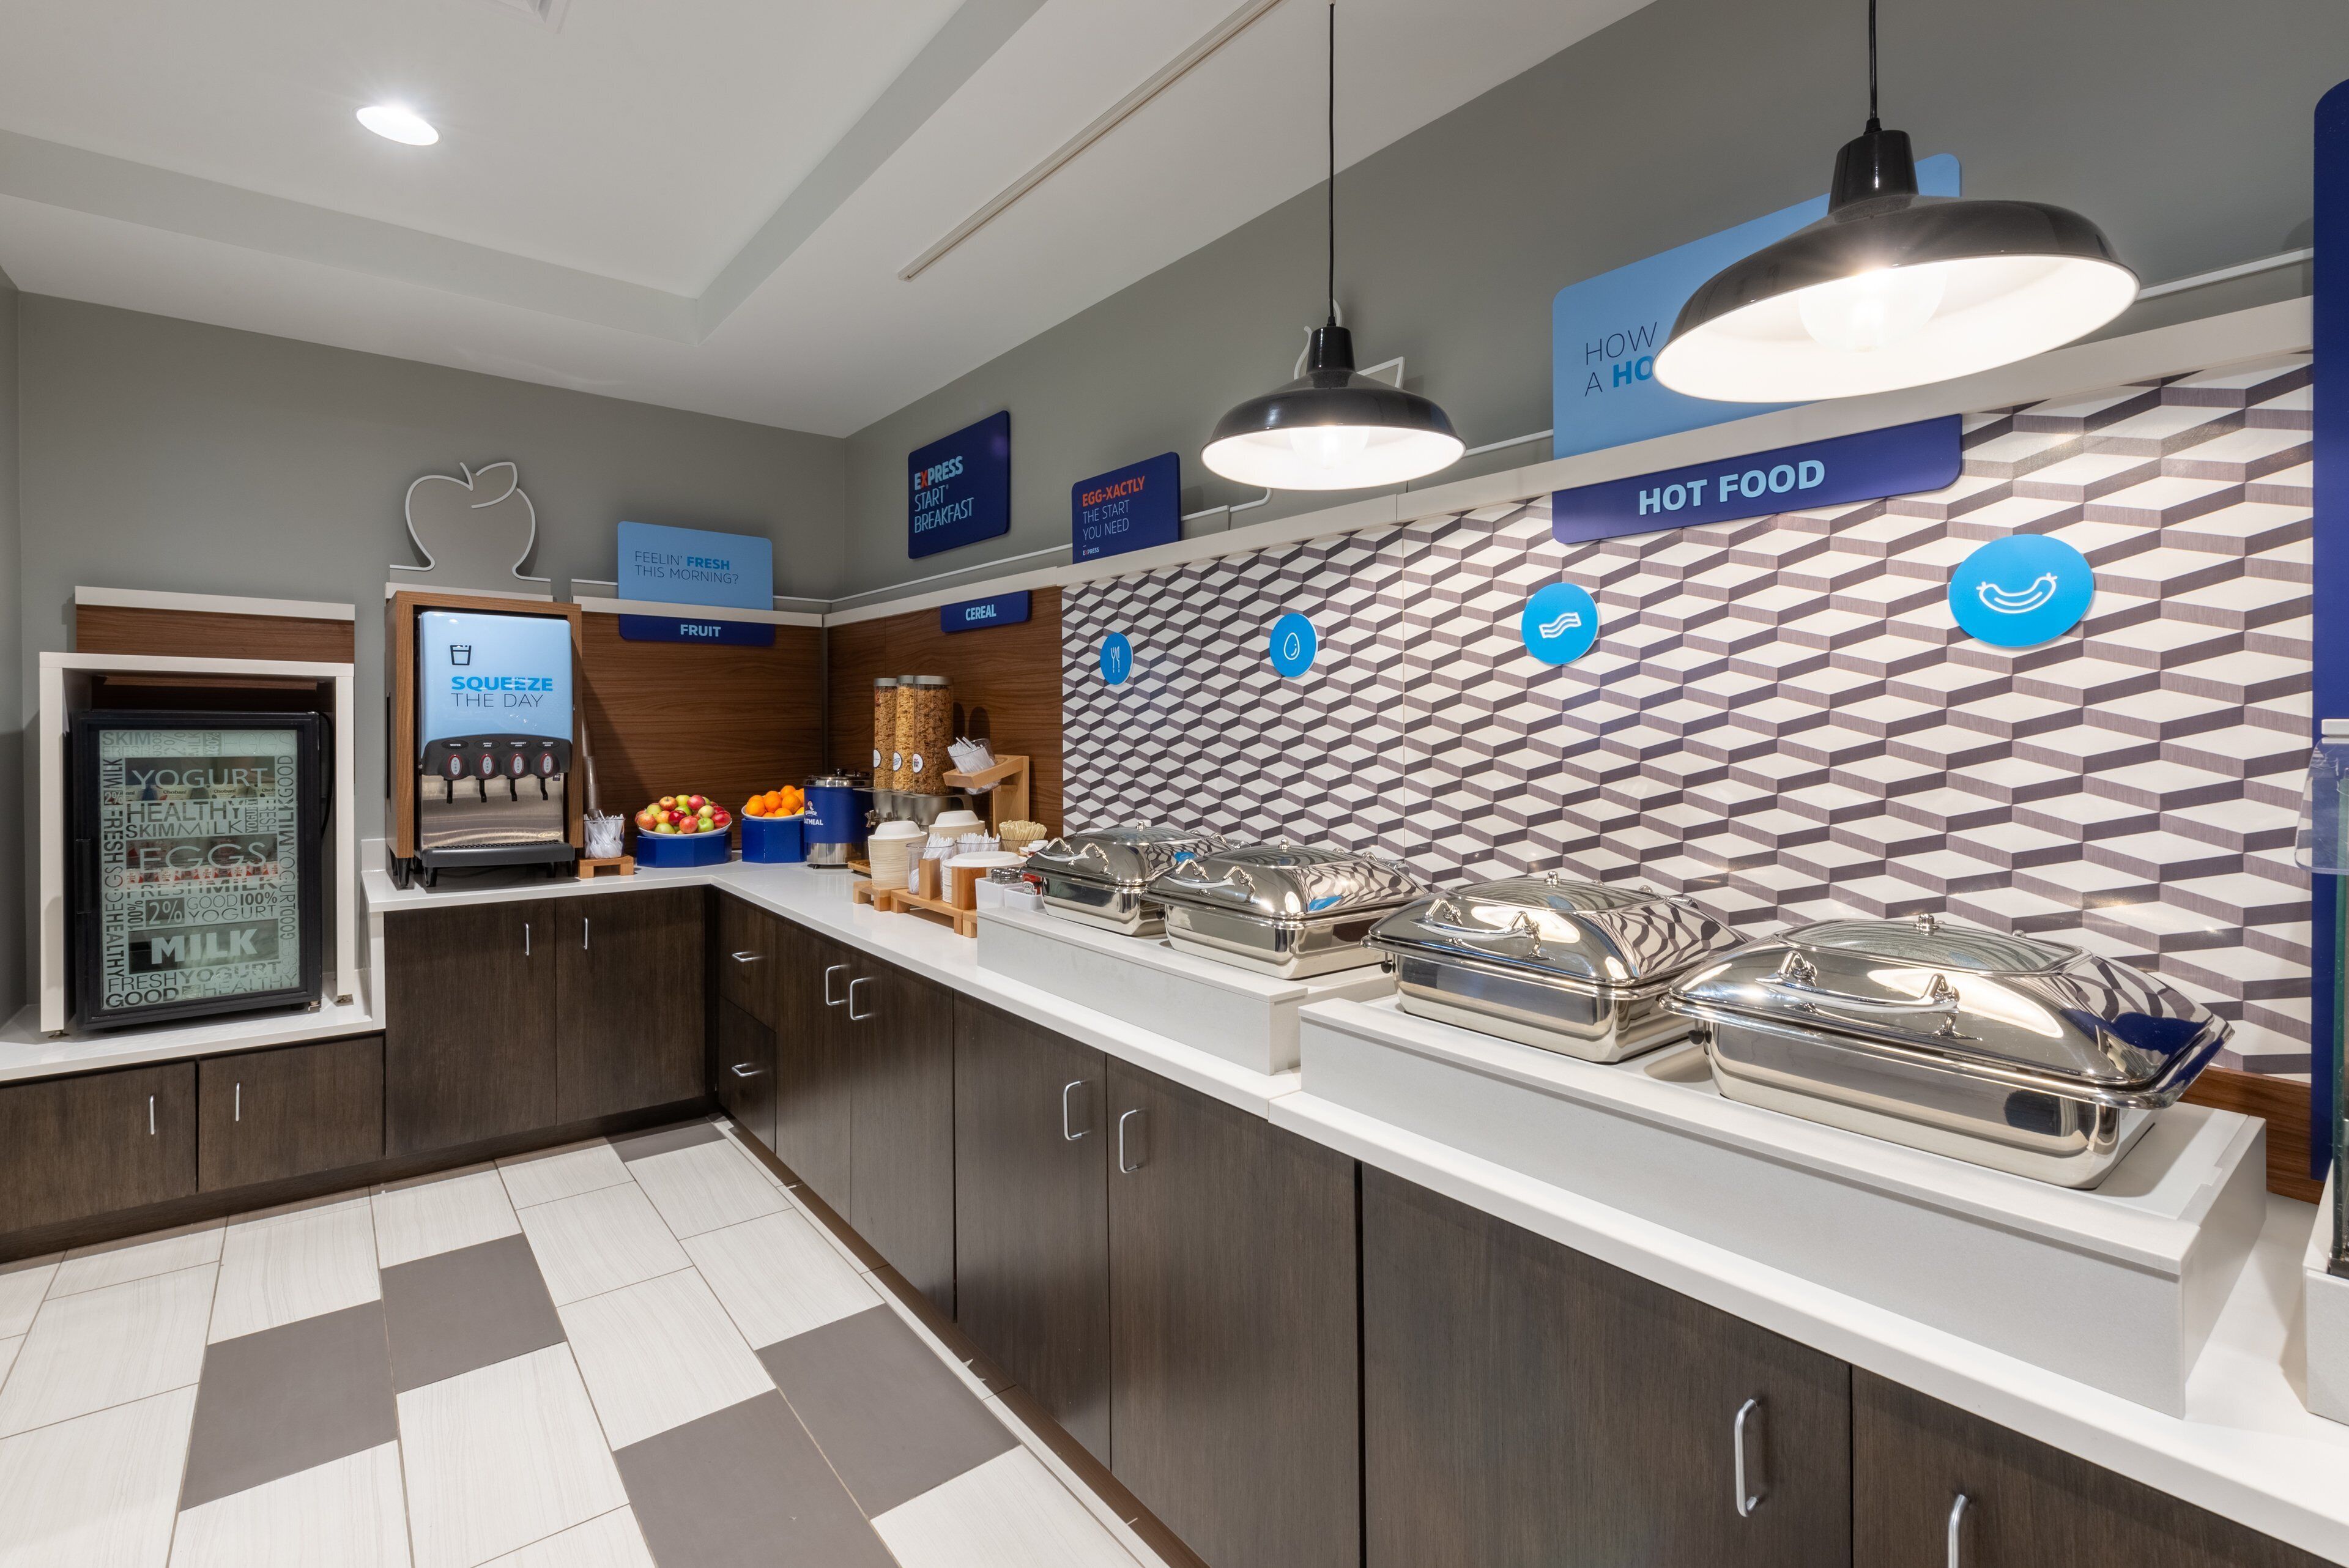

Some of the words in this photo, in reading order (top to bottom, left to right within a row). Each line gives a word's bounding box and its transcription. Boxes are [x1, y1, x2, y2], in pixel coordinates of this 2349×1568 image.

[1585, 321, 1657, 366] HOW
[1584, 371, 1603, 397] A
[914, 455, 963, 491] EXPRESS
[1082, 475, 1145, 507] EGG-XACTLY
[1639, 479, 1708, 516] HOT
[1719, 459, 1826, 503] FOOD
[914, 497, 974, 533] BREAKFAST
[1082, 507, 1099, 525] THE
[1102, 499, 1130, 519] START
[1082, 524, 1102, 541] YOU
[1105, 518, 1129, 536] NEED
[687, 556, 730, 570] FRESH
[1082, 547, 1100, 555] EXPRESS
[634, 565, 665, 578] THIS
[670, 568, 739, 584] MORNING?
[965, 604, 996, 622] CEREAL
[680, 624, 721, 637] FRUIT
[451, 676, 553, 692] SQUEEZE
[451, 693, 494, 707] THE
[504, 693, 544, 708] DAY
[102, 731, 152, 746] SKIM
[102, 758, 123, 789] MILK
[131, 768, 268, 790] YOGURT
[276, 755, 294, 798] GOOD
[104, 790, 123, 805] 2%
[127, 800, 243, 823] HEALTHY
[278, 798, 294, 846] MILK
[103, 809, 124, 864] FRESH
[125, 823, 174, 839] SKIM
[176, 819, 243, 836] MILK
[139, 842, 267, 874] EGGS
[105, 866, 124, 912] EGGS
[278, 846, 295, 910] YOGURT
[148, 900, 183, 925] 2%
[187, 894, 238, 910] GOOD
[240, 891, 278, 906] 100%
[188, 904, 276, 923] YOGURT
[127, 900, 144, 930] 100%
[279, 908, 296, 940] GOOD
[105, 913, 125, 977] HEALTHY
[151, 928, 258, 965] MILK
[108, 972, 177, 992] FRESH
[179, 960, 281, 984] YOGURT
[202, 973, 297, 997] HEALTHY
[105, 987, 179, 1008] GOOD
